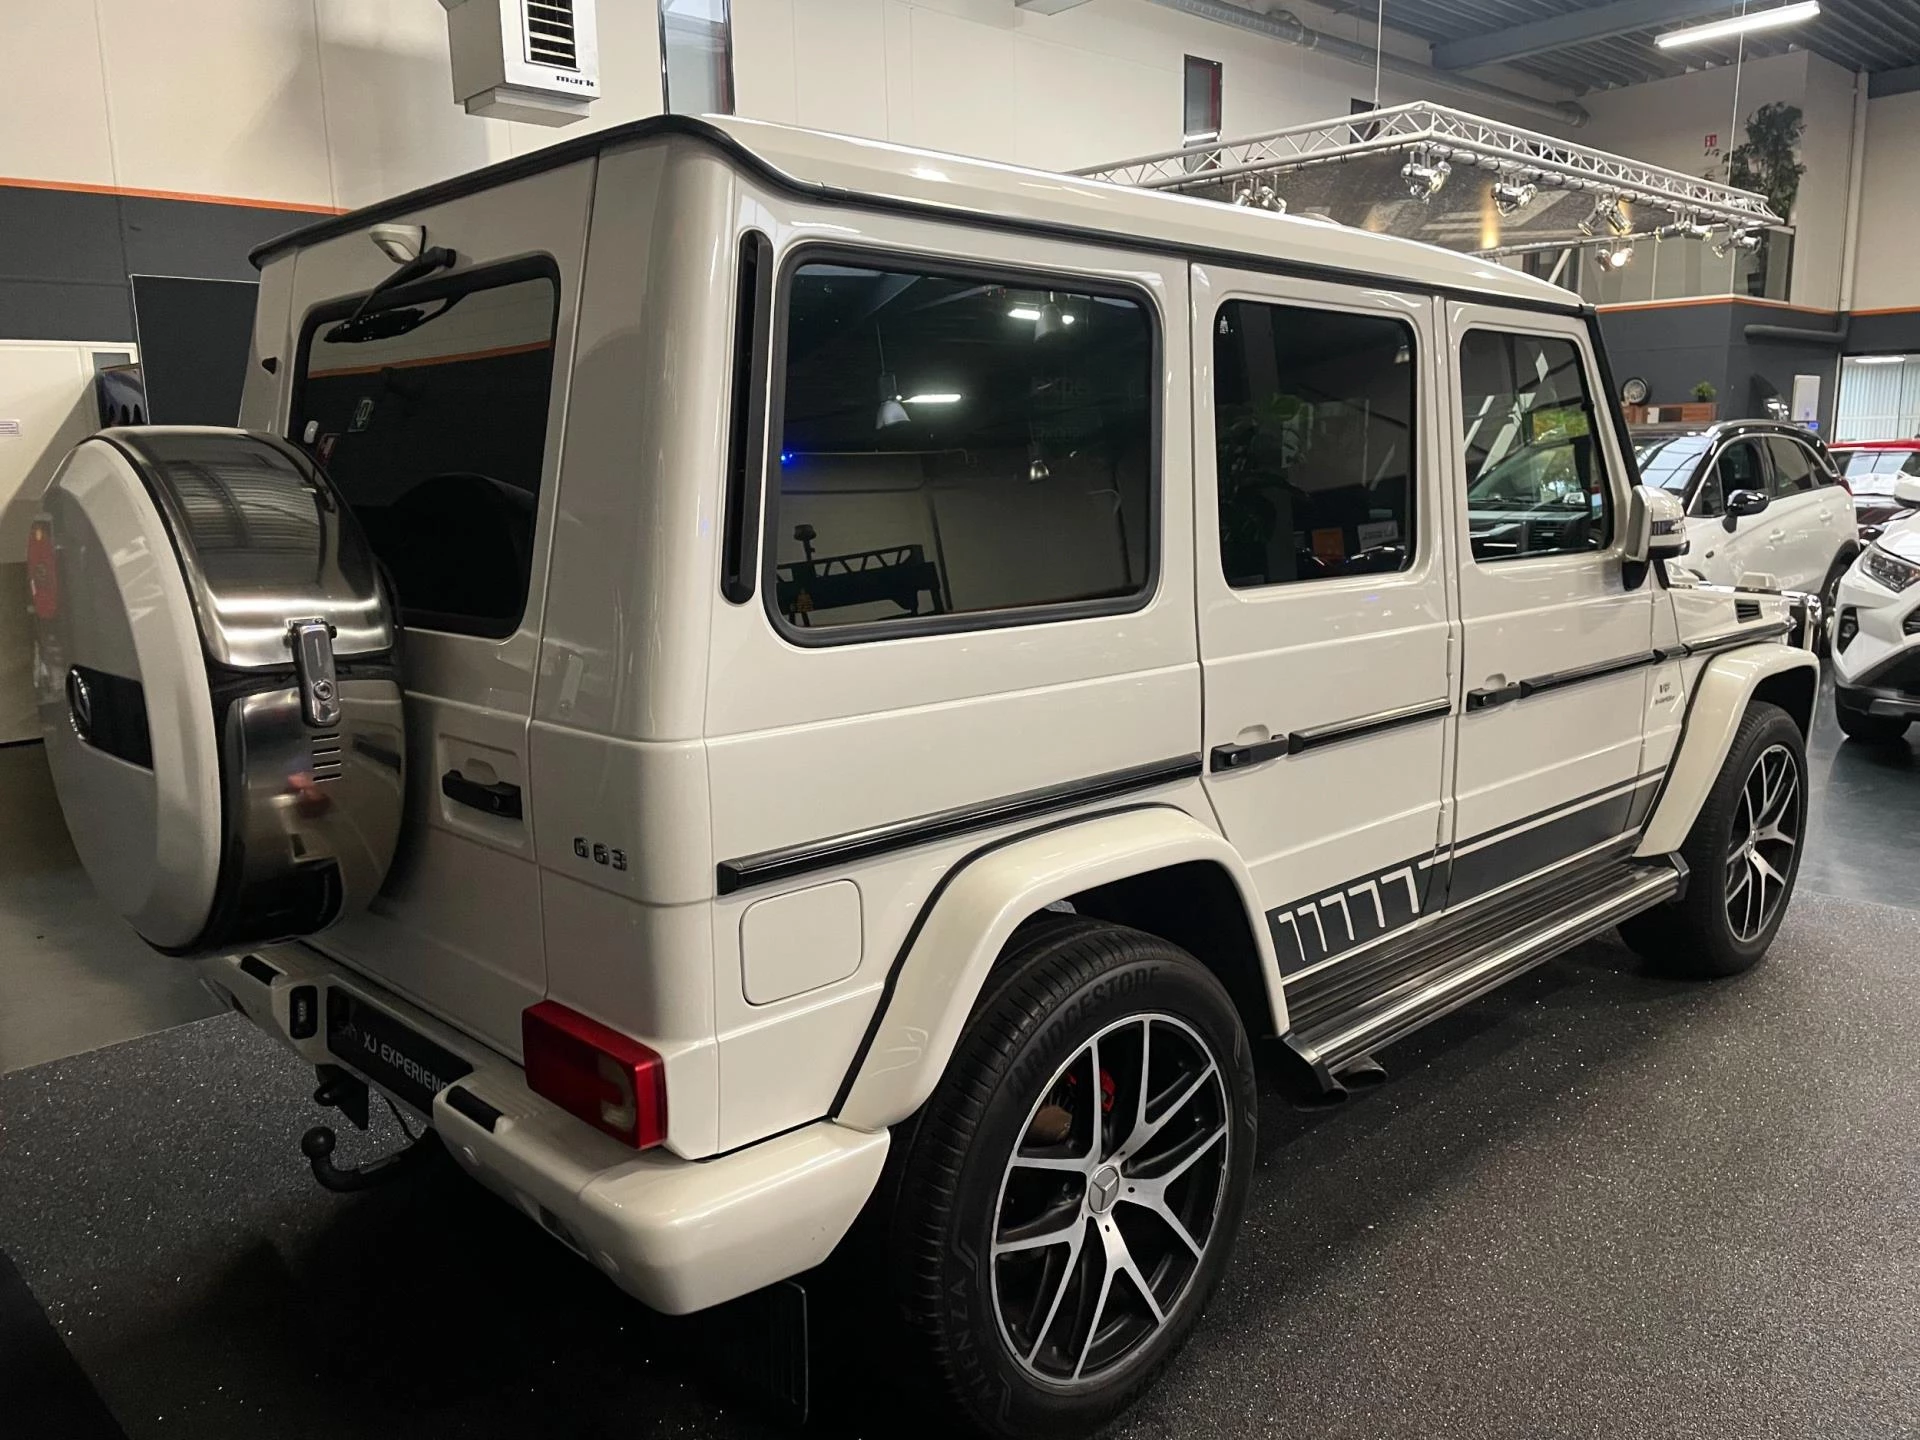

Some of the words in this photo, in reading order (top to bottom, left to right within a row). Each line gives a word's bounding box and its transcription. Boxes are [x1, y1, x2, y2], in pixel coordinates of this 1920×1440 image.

[556, 75, 594, 87] mark
[574, 837, 628, 871] G63
[363, 1031, 378, 1053] XJ
[1007, 966, 1160, 1097] BRIDGESTONE
